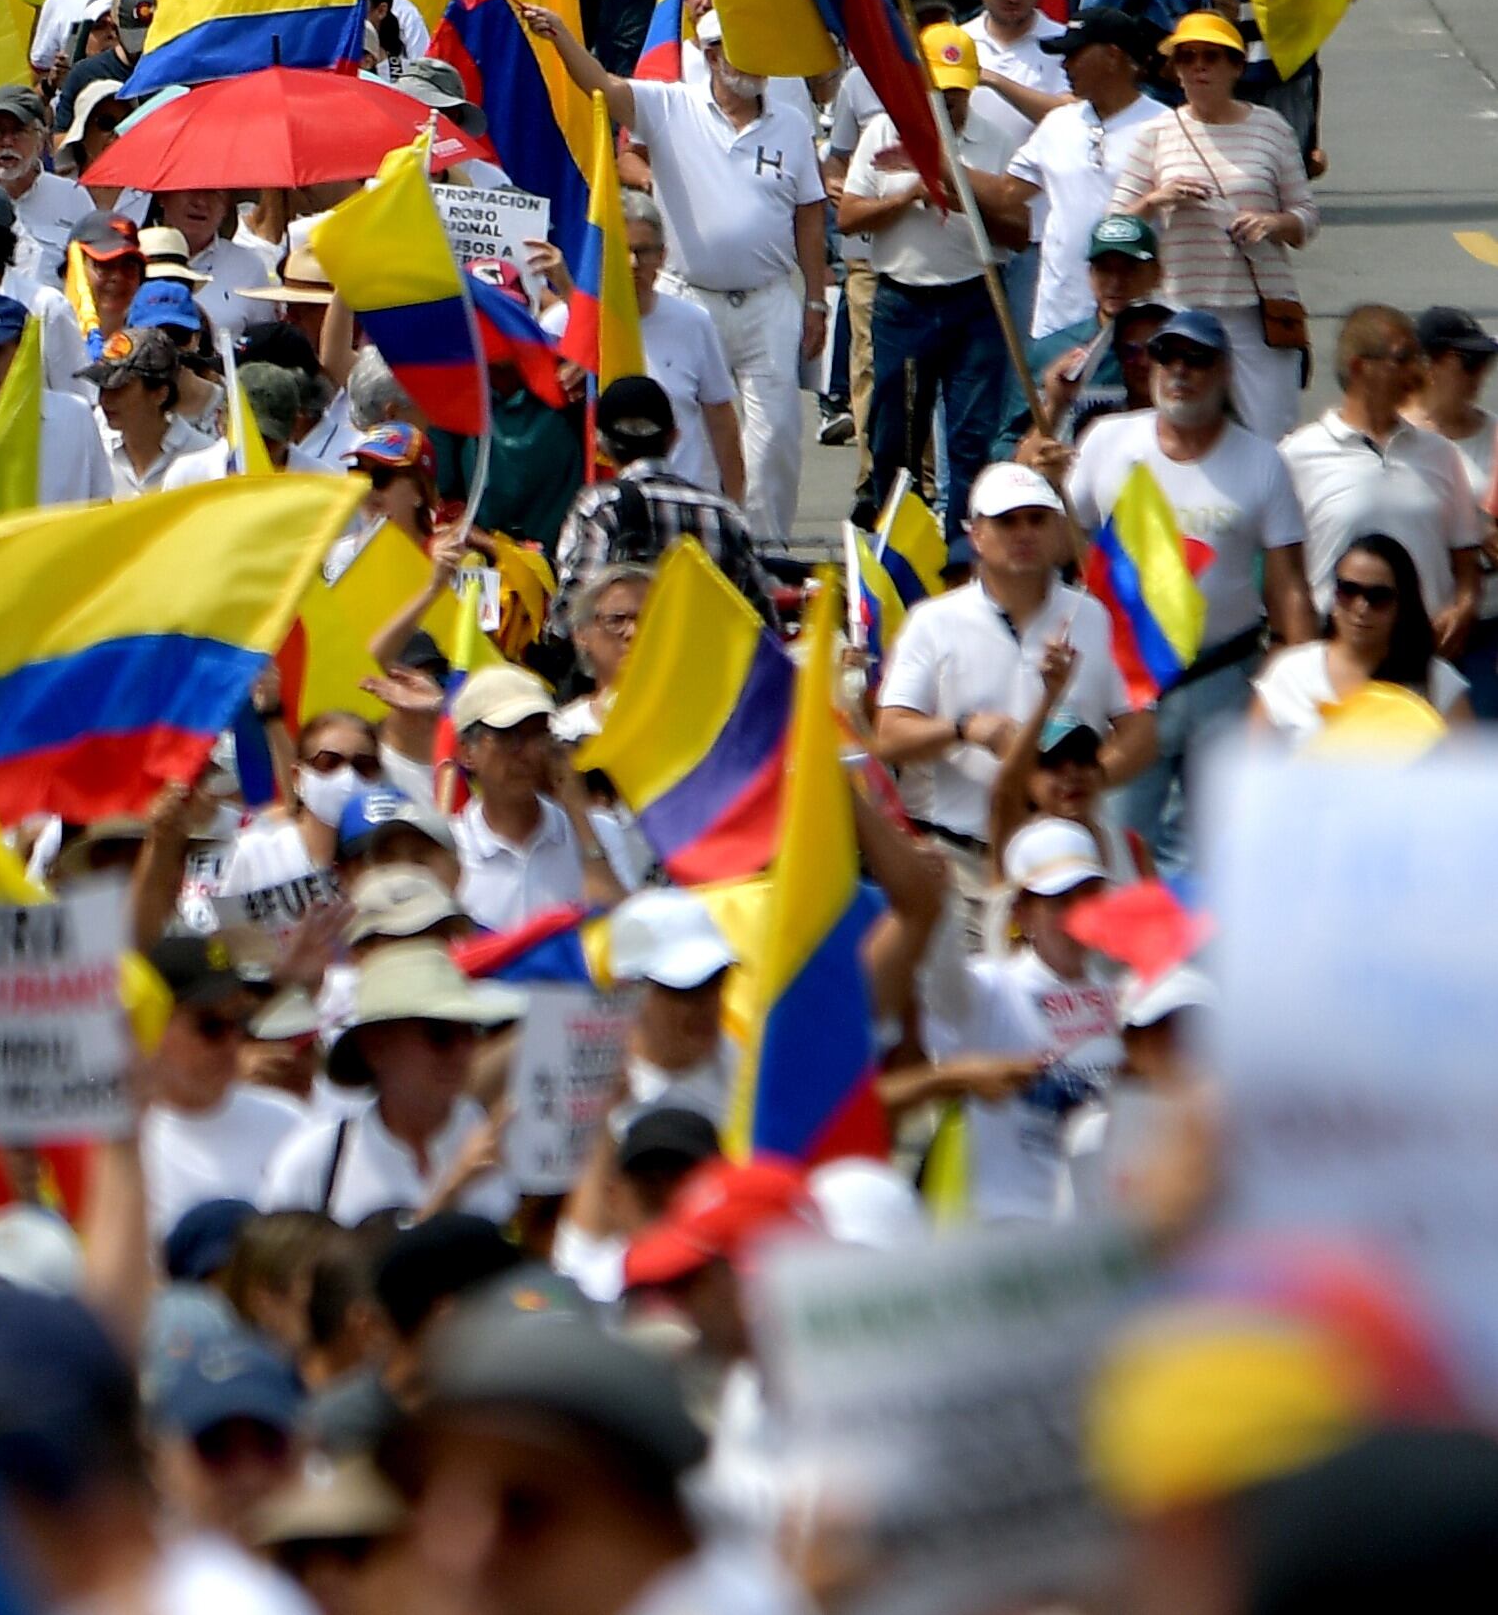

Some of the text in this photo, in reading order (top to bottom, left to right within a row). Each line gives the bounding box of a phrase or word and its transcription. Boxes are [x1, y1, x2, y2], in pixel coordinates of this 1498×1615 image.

[756, 145, 783, 179] H
[448, 206, 498, 223] ROBO
[501, 245, 513, 257] A
[243, 866, 341, 921] #FUER
